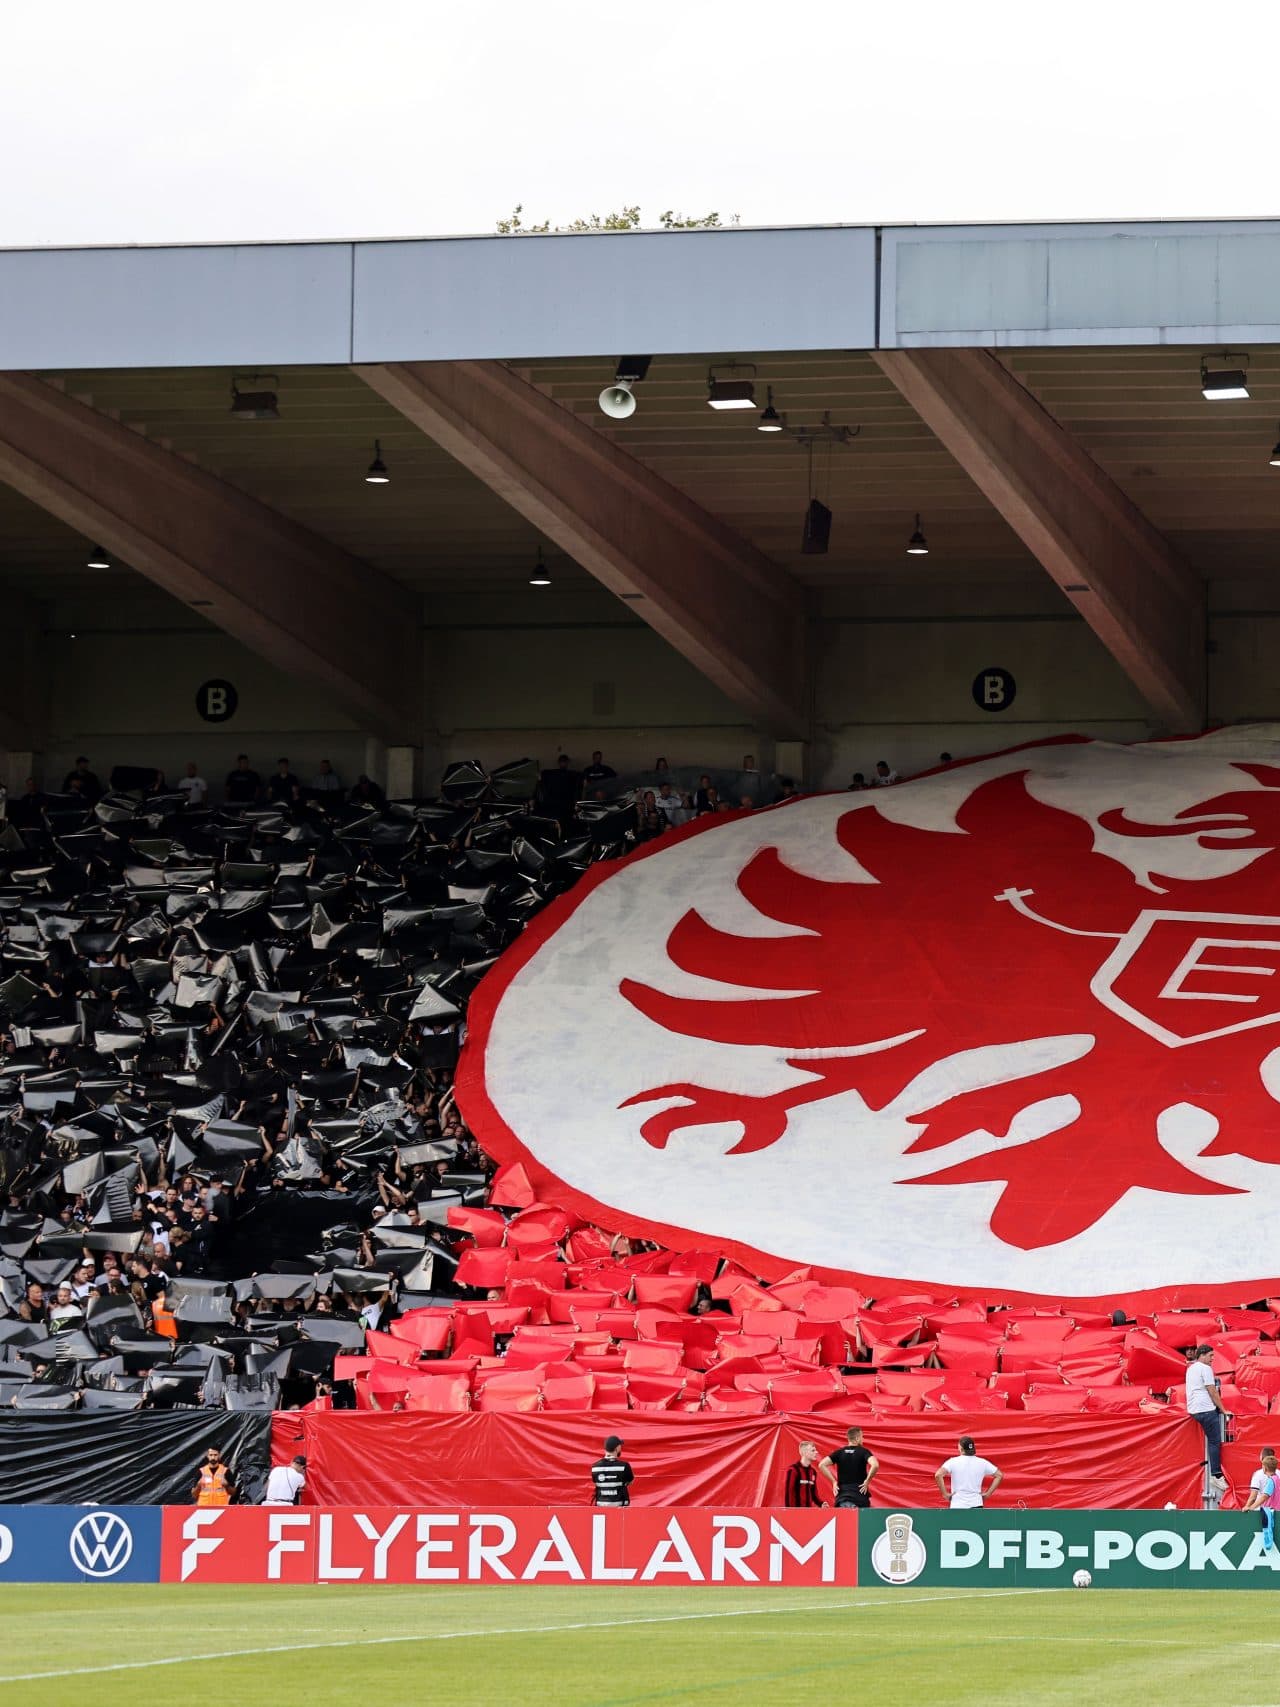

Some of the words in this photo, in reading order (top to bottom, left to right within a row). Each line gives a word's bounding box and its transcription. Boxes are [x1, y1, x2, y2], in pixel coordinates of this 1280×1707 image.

[207, 687, 226, 714] B
[984, 676, 1004, 703] B
[267, 1513, 837, 1582] FLYERALARM
